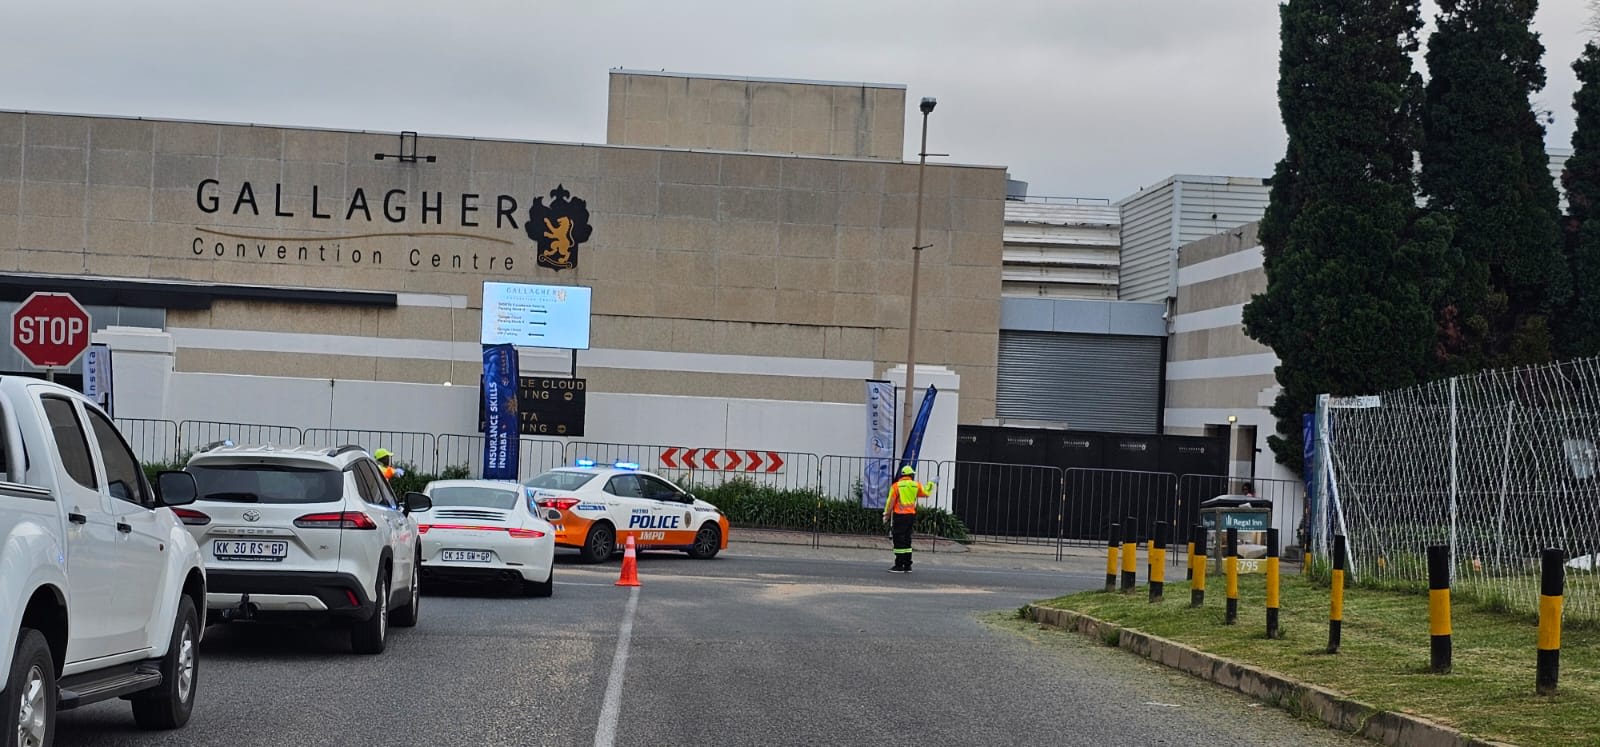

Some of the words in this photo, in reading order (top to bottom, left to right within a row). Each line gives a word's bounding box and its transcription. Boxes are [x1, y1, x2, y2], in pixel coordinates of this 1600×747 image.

[196, 178, 519, 230] GALLAGHER
[192, 238, 382, 264] Convention
[409, 248, 514, 270] Centre
[19, 315, 84, 346] STOP
[88, 351, 96, 397] inseta
[542, 380, 585, 391] CLOUD
[489, 382, 498, 413] SKILLS
[489, 414, 499, 469] INSURANCE
[498, 432, 507, 469] INDABA
[628, 514, 681, 529] POLICE
[638, 531, 665, 541] JMPD
[1233, 518, 1251, 527] Regal
[1252, 519, 1263, 527] Inn
[216, 542, 229, 554] KK
[234, 542, 246, 554] 30
[249, 542, 263, 554] RS
[271, 543, 284, 555] GP
[444, 551, 453, 560] CK
[455, 551, 464, 560] 15
